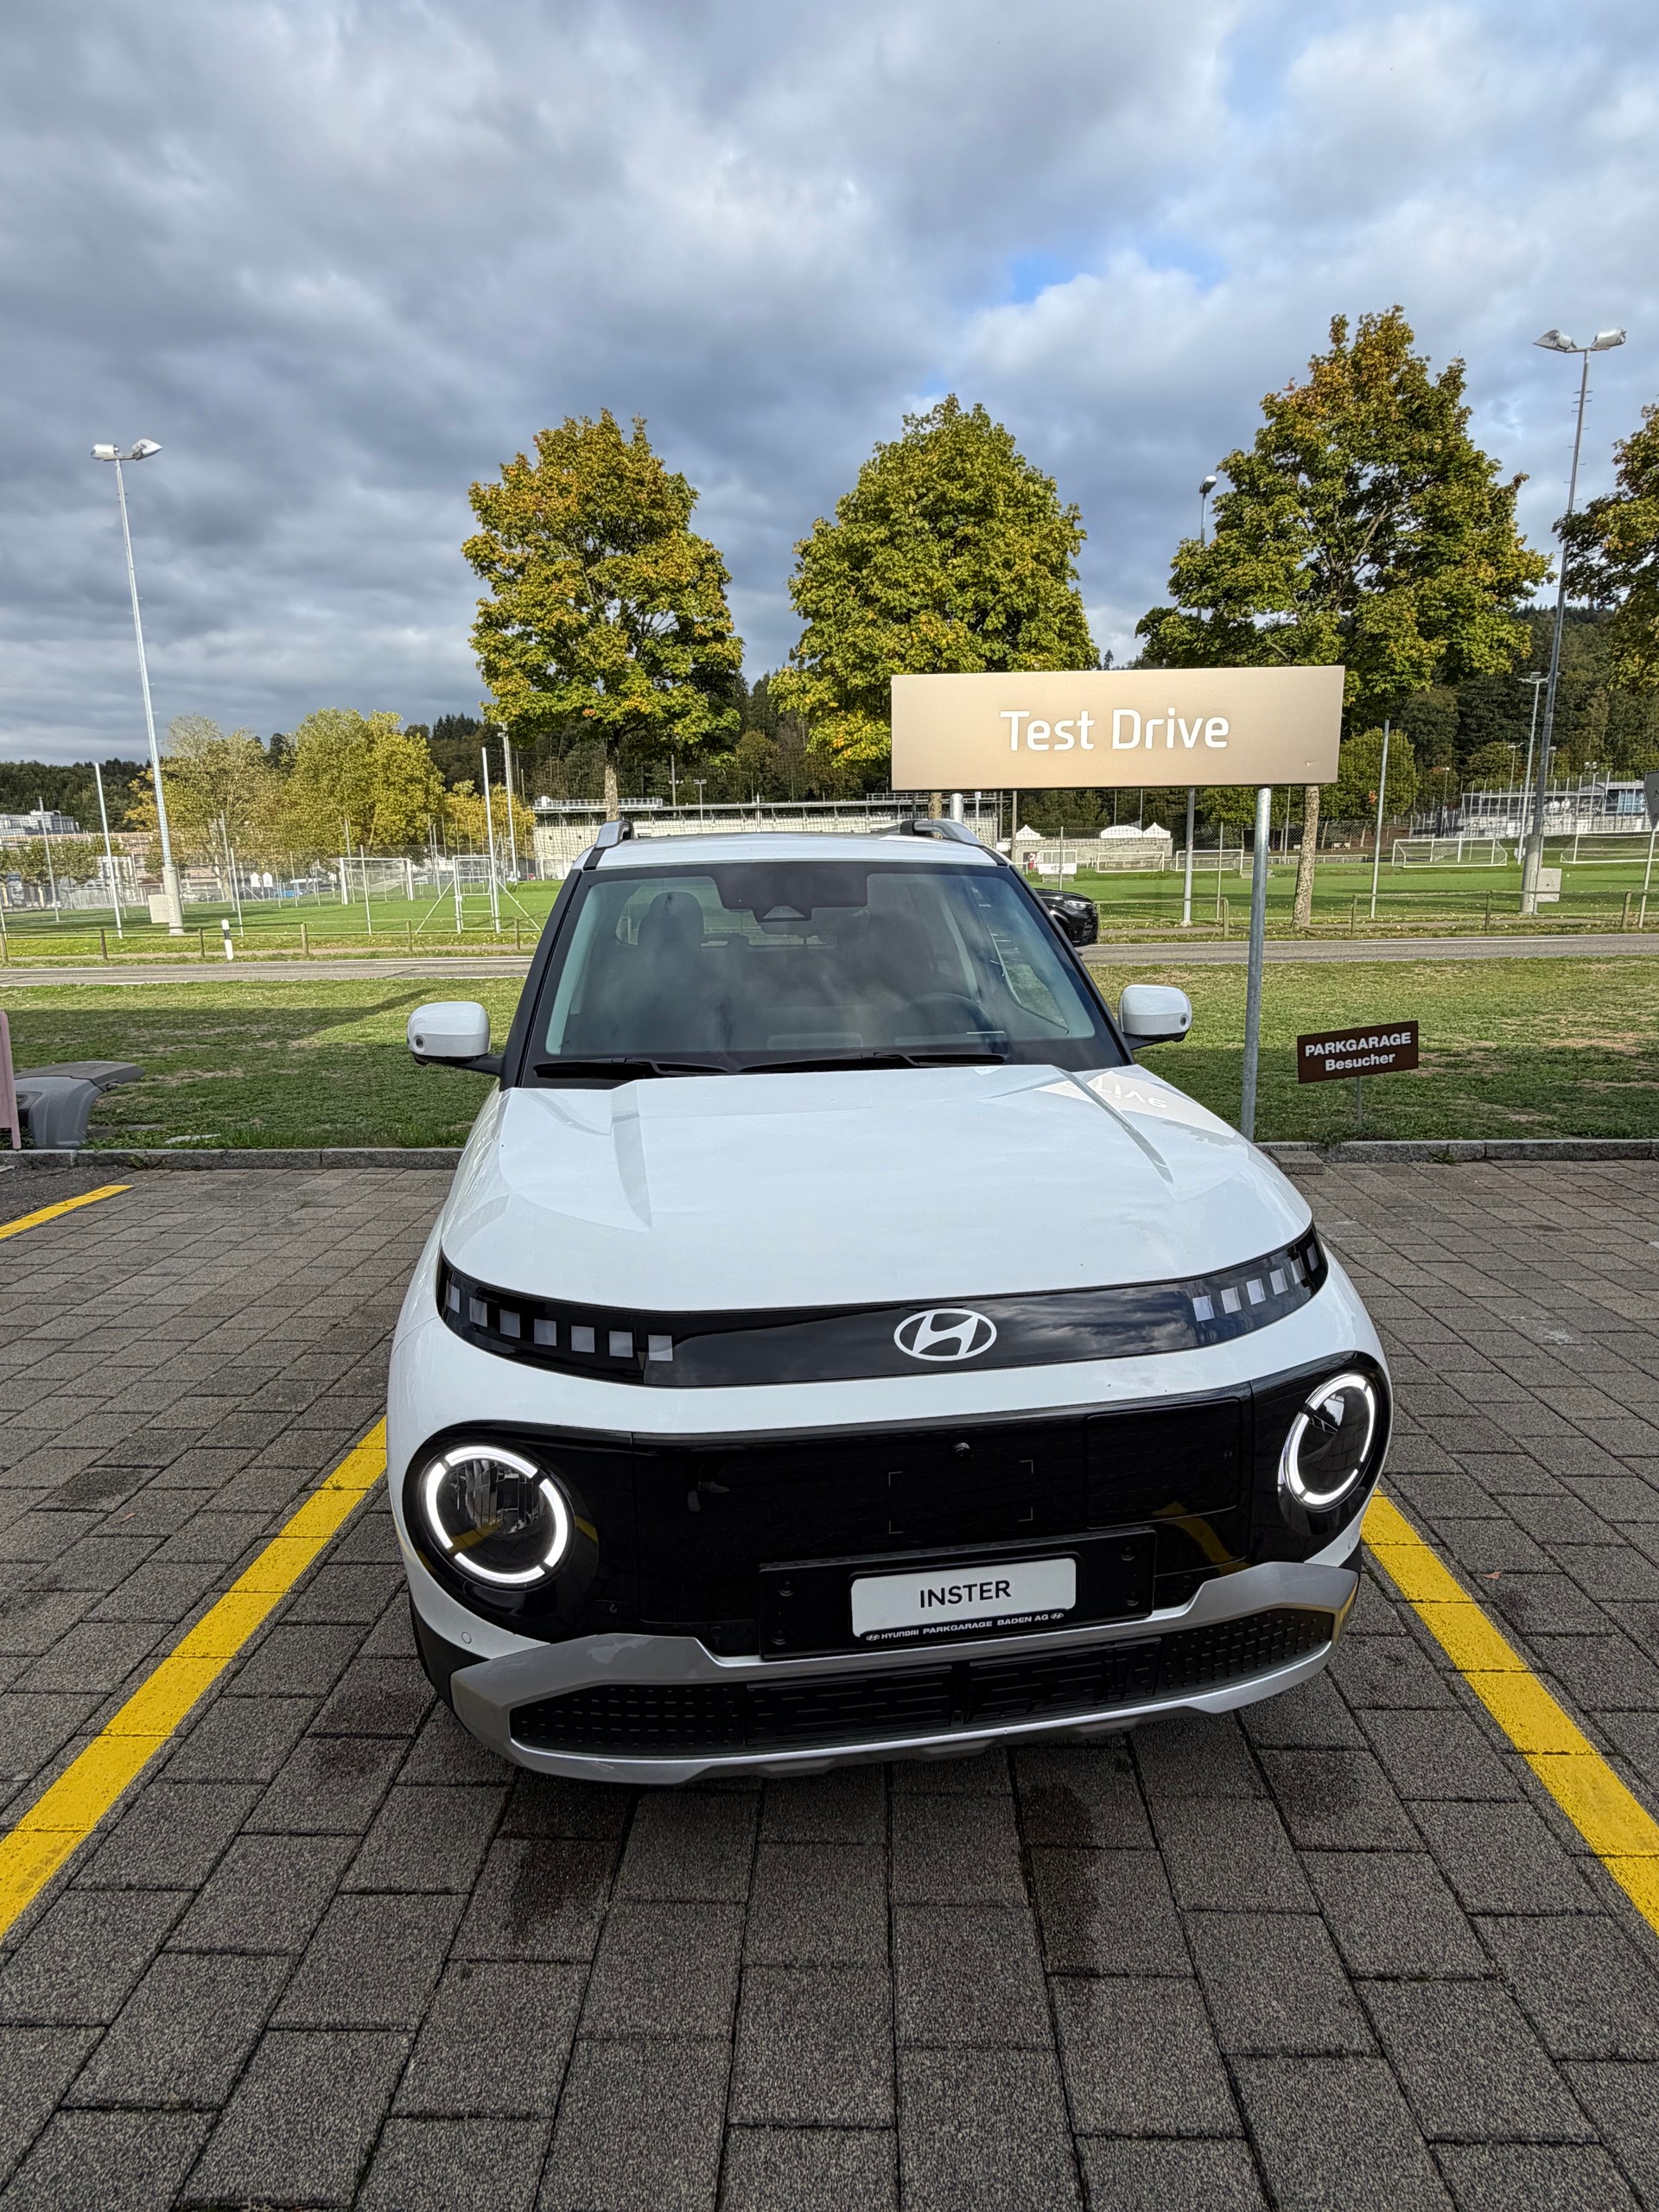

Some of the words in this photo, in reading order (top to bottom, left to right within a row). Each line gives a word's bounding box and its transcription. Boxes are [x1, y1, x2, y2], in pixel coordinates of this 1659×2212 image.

[1000, 710, 1095, 751] Test
[1112, 707, 1230, 749] Drive
[1305, 1032, 1412, 1057] PARKGARAGE
[1325, 1052, 1395, 1071] Besucher
[919, 1580, 1012, 1608] INSTER
[881, 1630, 919, 1640] HYUNDAI
[923, 1620, 993, 1634] PARKGARAGE
[997, 1616, 1033, 1626] BADEN
[1034, 1613, 1049, 1622] AG
